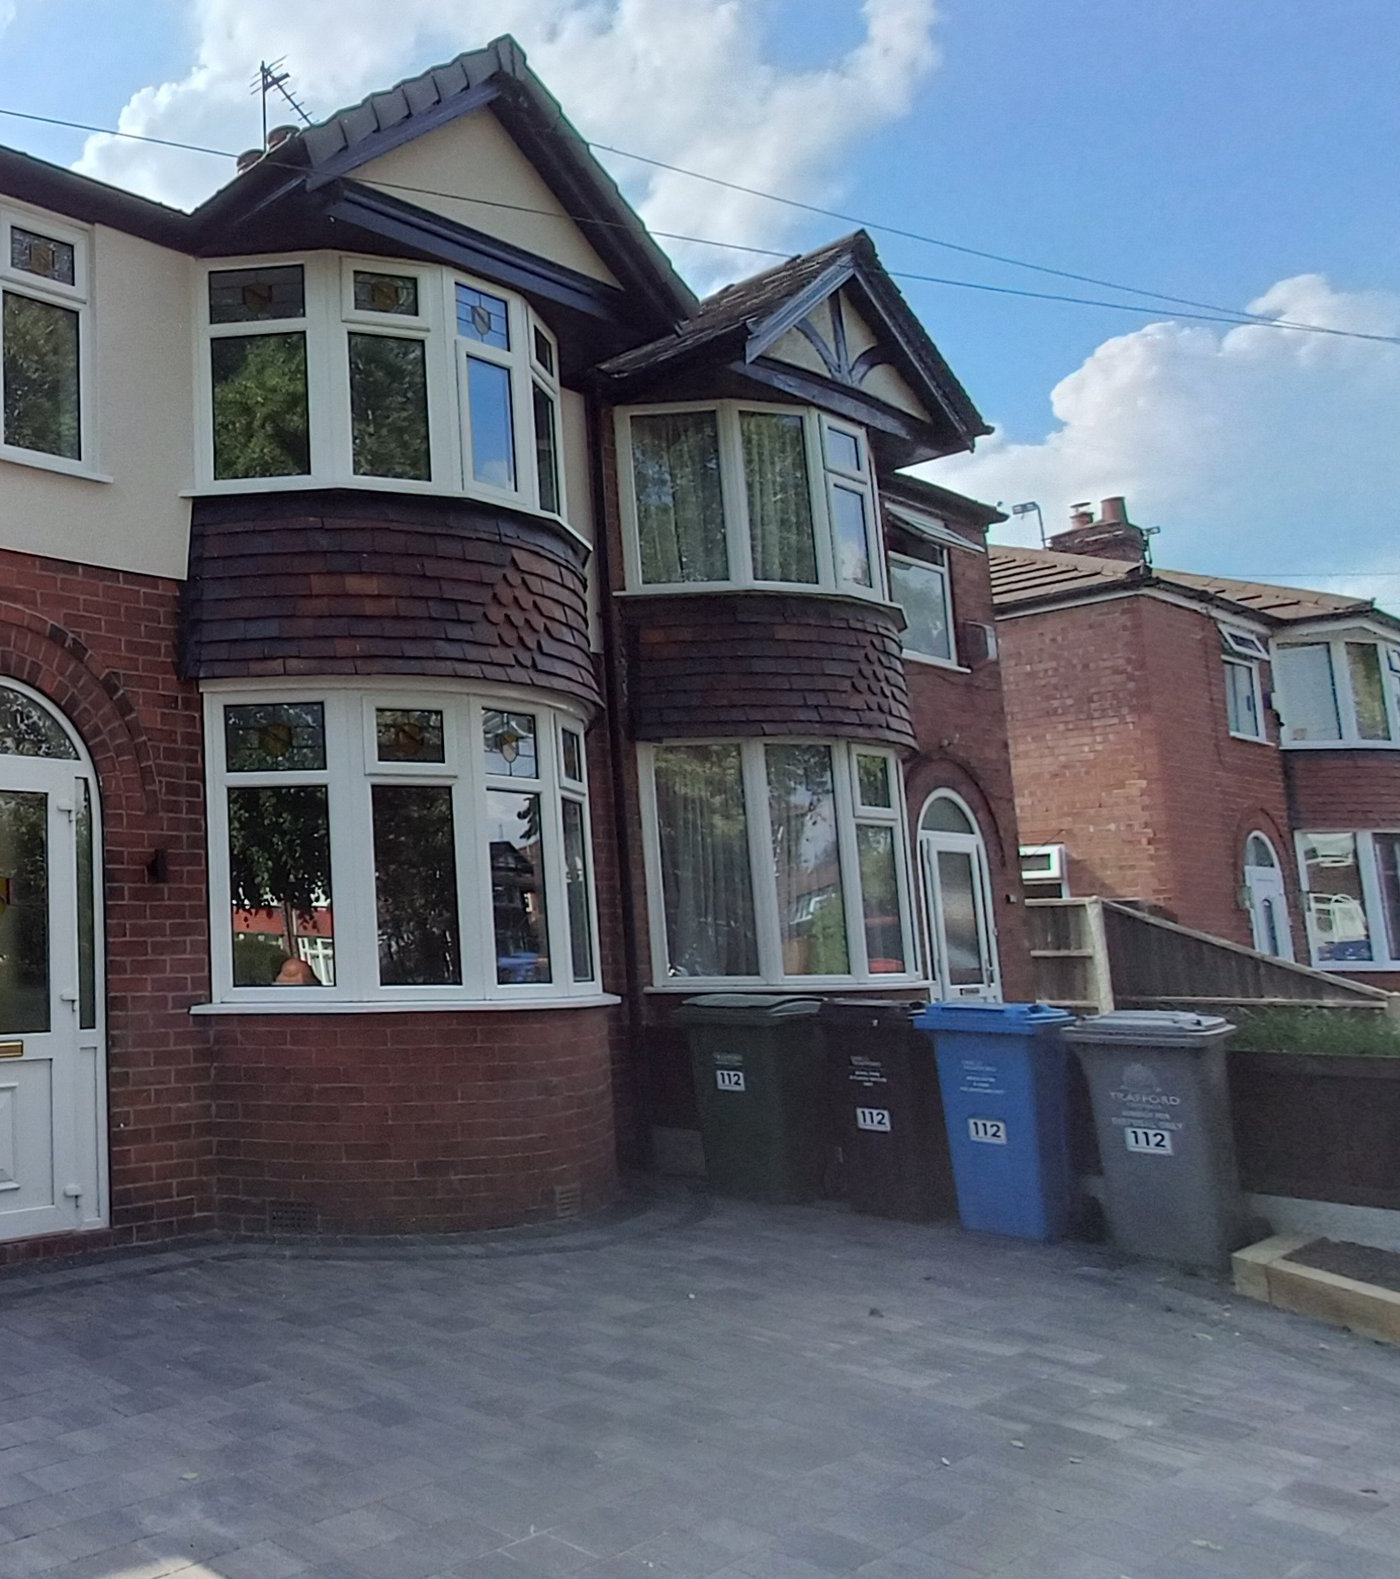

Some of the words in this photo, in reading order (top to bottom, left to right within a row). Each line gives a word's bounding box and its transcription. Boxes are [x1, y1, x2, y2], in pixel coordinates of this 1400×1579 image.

[720, 1071, 742, 1087] 112
[860, 1110, 887, 1126] 112
[972, 1120, 1002, 1139] 112
[1130, 1130, 1167, 1148] 112
